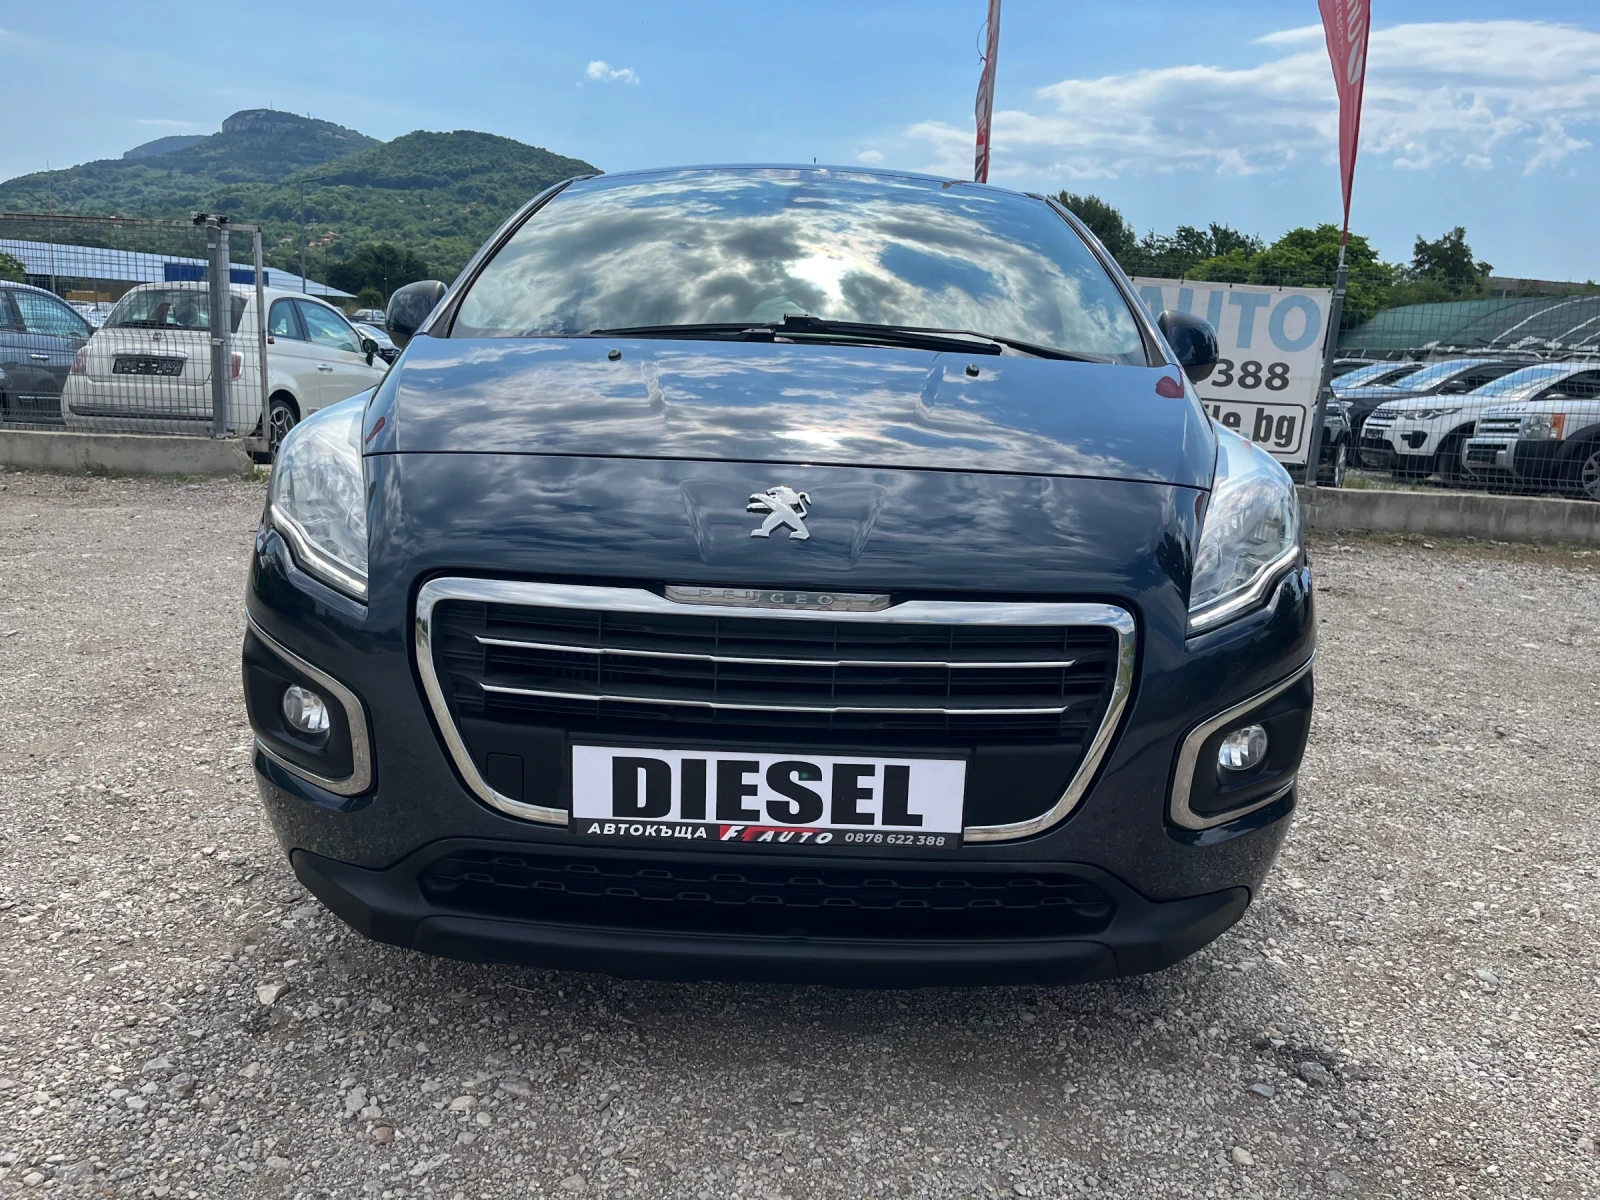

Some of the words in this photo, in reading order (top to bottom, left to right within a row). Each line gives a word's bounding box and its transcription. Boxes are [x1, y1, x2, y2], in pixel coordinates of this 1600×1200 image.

[1211, 358, 1290, 391] 388
[699, 589, 858, 606] PEUGEOT
[611, 756, 923, 827] DIESEL
[587, 822, 707, 840] АВТОКЪЩА
[757, 830, 834, 845] AUTO
[844, 832, 883, 844] 0878
[886, 834, 913, 845] 622
[916, 835, 946, 846] 388
